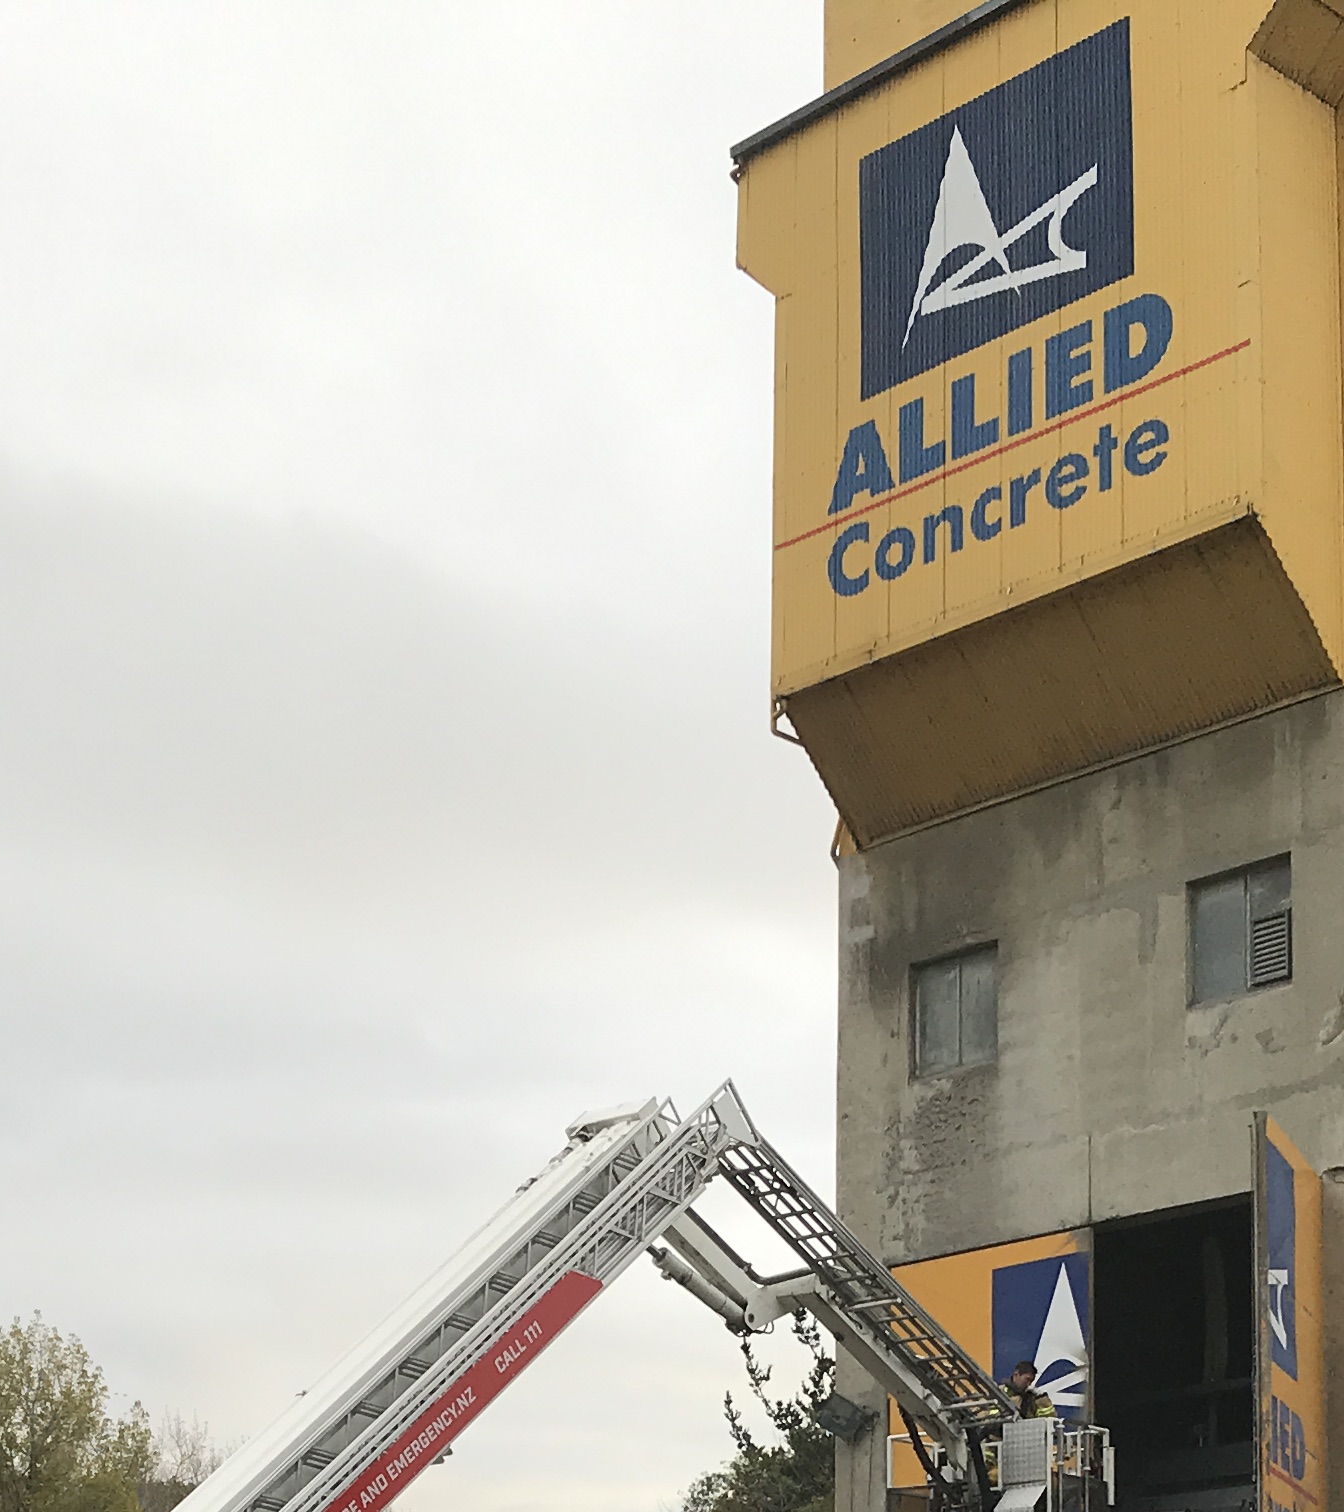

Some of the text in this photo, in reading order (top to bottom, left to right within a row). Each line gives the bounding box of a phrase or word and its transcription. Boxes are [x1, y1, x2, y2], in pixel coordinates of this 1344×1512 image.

[827, 293, 1174, 516] ALLIED
[827, 418, 1171, 598] Concrete
[359, 1473, 389, 1509] AND
[385, 1386, 478, 1481] EMERGENCY.NZ
[493, 1338, 527, 1374] CALL
[523, 1320, 544, 1344] 111
